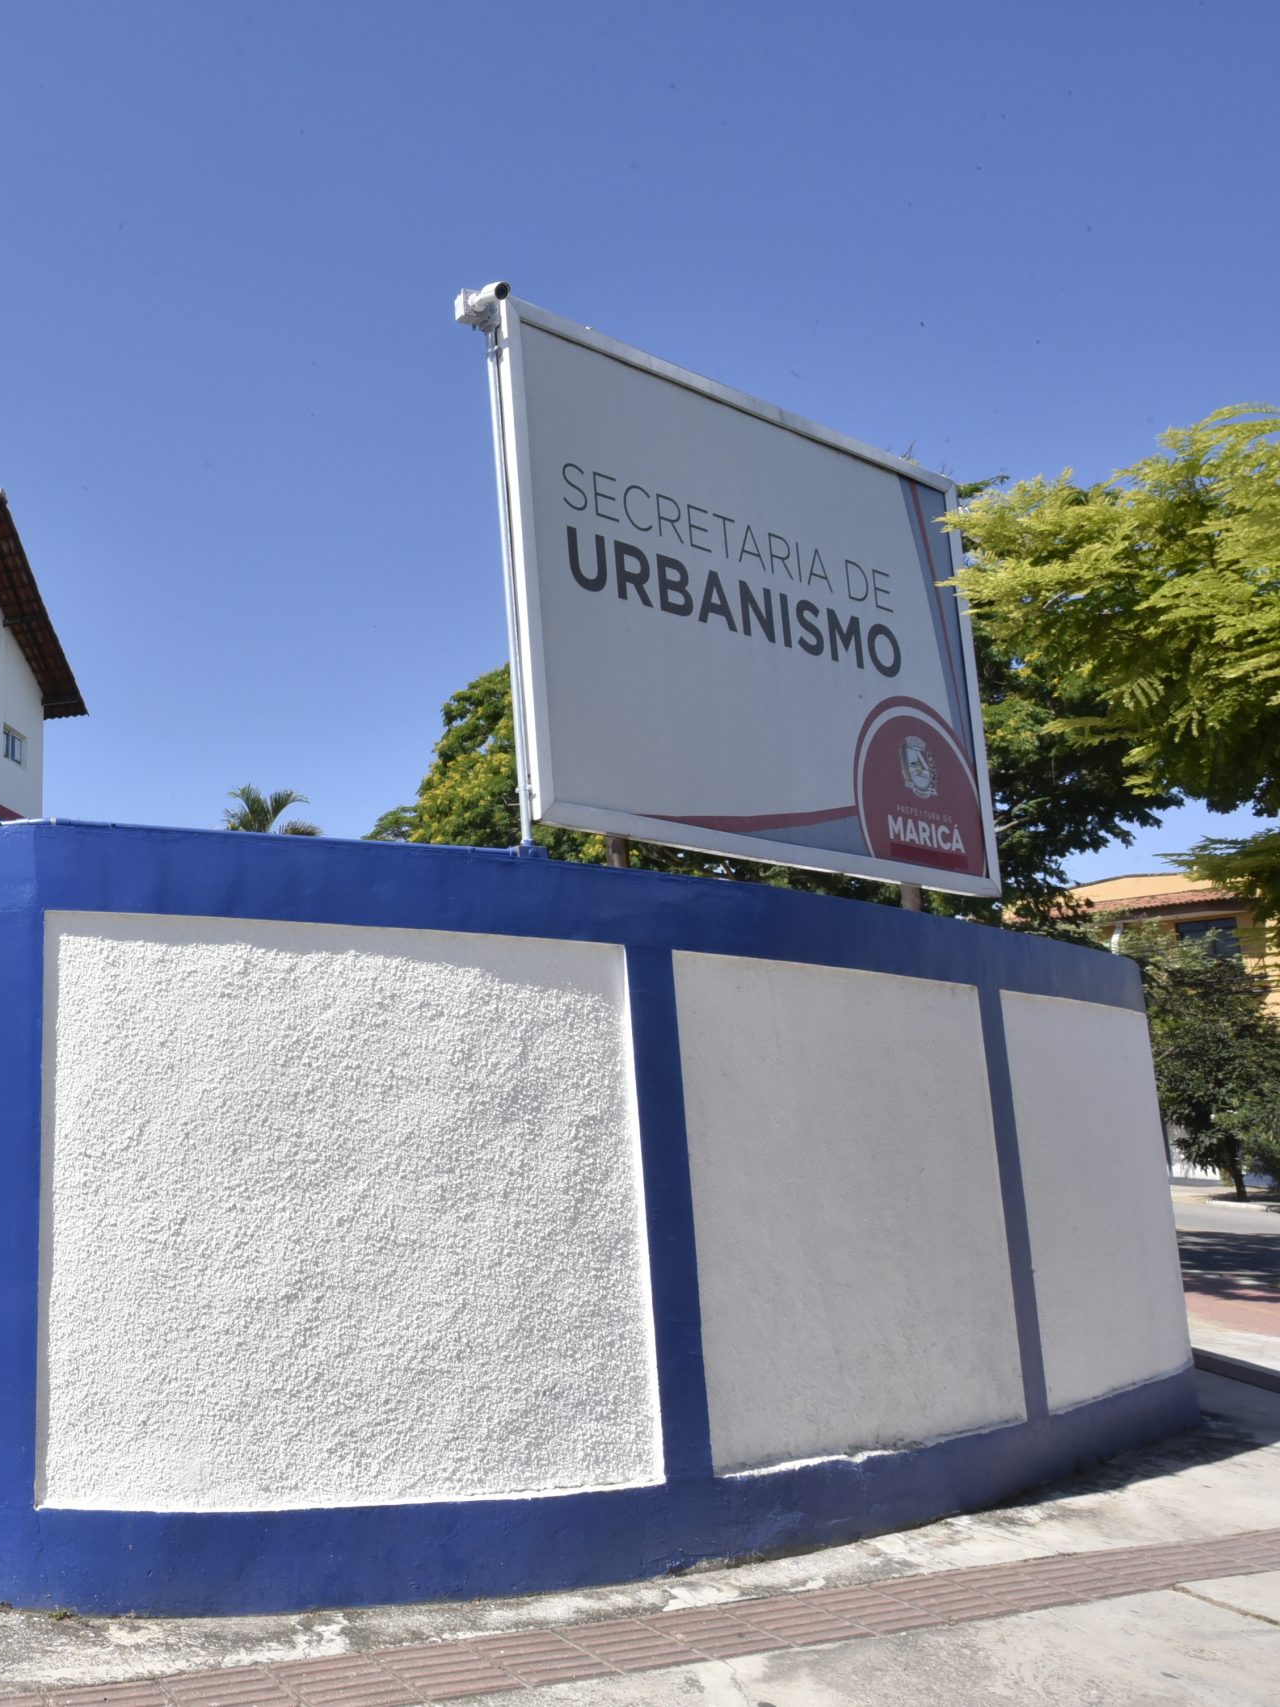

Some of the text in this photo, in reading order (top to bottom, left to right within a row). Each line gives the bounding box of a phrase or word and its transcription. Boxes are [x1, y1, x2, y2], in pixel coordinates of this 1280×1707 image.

[562, 462, 895, 613] SECRETARIA DE
[565, 525, 902, 678] URBANISMO
[887, 814, 966, 853] MARICÁ
[897, 804, 952, 824] PREFEITURA DE
